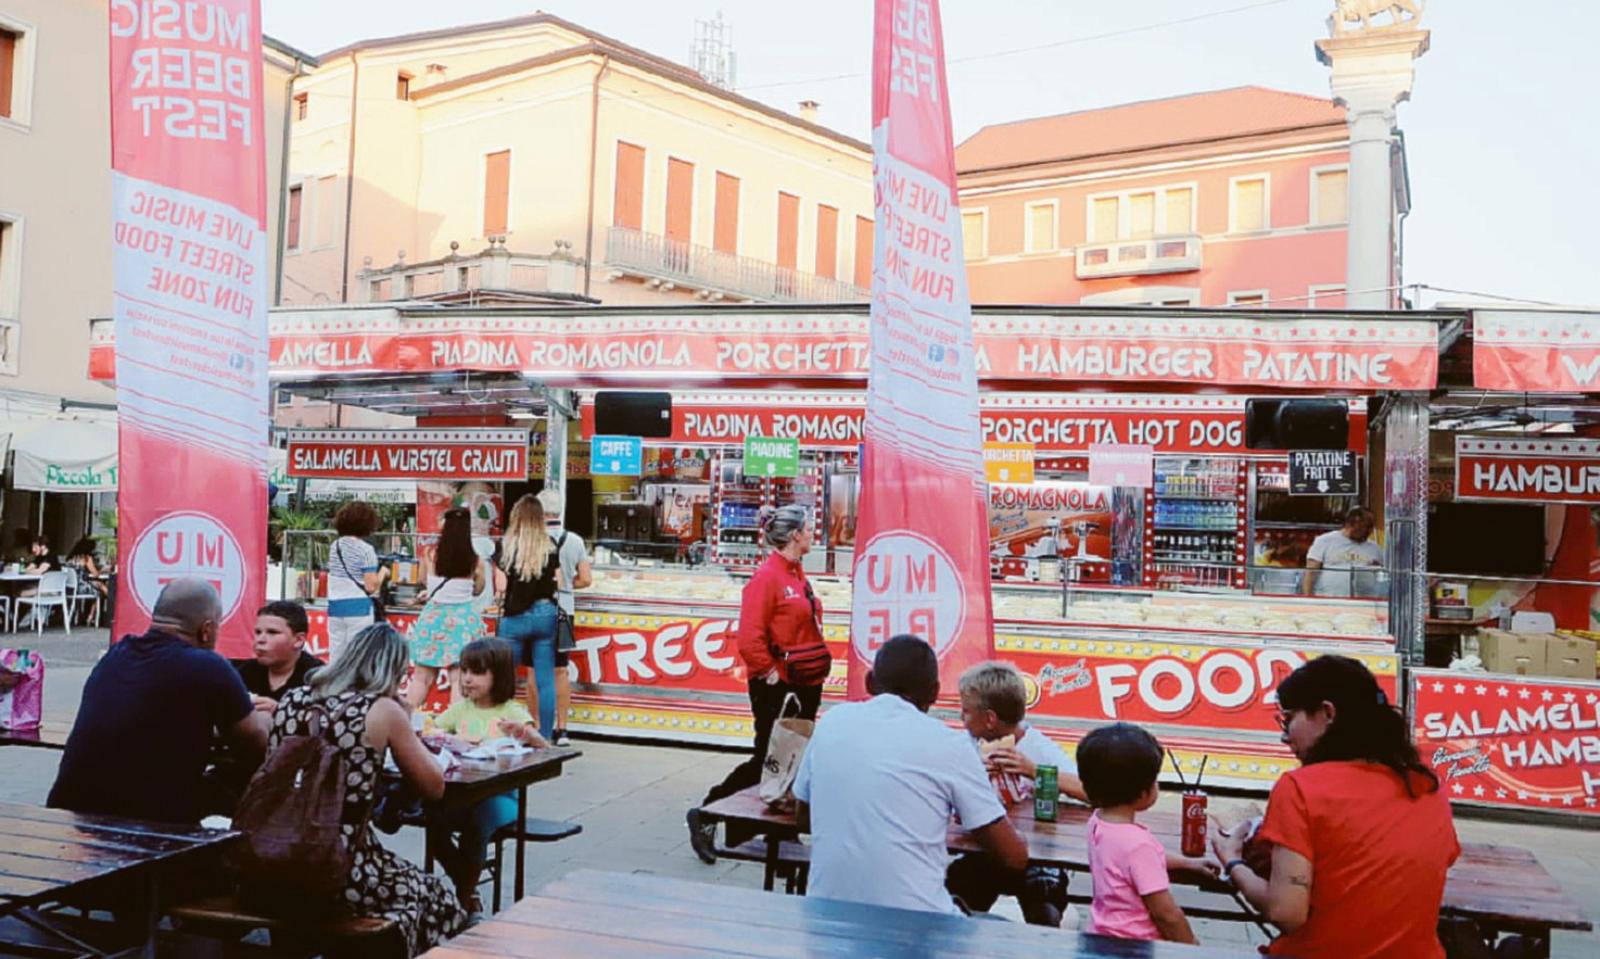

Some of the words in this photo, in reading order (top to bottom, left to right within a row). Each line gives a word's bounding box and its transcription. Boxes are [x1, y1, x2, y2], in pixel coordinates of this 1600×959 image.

[268, 340, 373, 366] AMELLA
[431, 339, 520, 367] PIADINA
[530, 340, 692, 367] ROMAGNOLA
[1017, 344, 1214, 378] HAMBURGER
[1243, 350, 1393, 384] PATATINE
[683, 412, 765, 439] PIADINA
[772, 412, 867, 439] ROMAGN
[982, 417, 1118, 445] PORCHETTA
[1127, 418, 1181, 446] HOT
[1189, 419, 1242, 448] DOG
[294, 450, 381, 472] SALAMELLA
[388, 450, 457, 472] WURSTEL
[750, 441, 794, 459] PIADINE
[1295, 451, 1351, 467] PATATINE
[46, 464, 102, 486] Piccola
[1303, 466, 1344, 480] FRITTE
[991, 485, 1110, 513] ROMAGNOLA
[567, 620, 740, 685] TREE
[1423, 702, 1600, 739] SALAMEL
